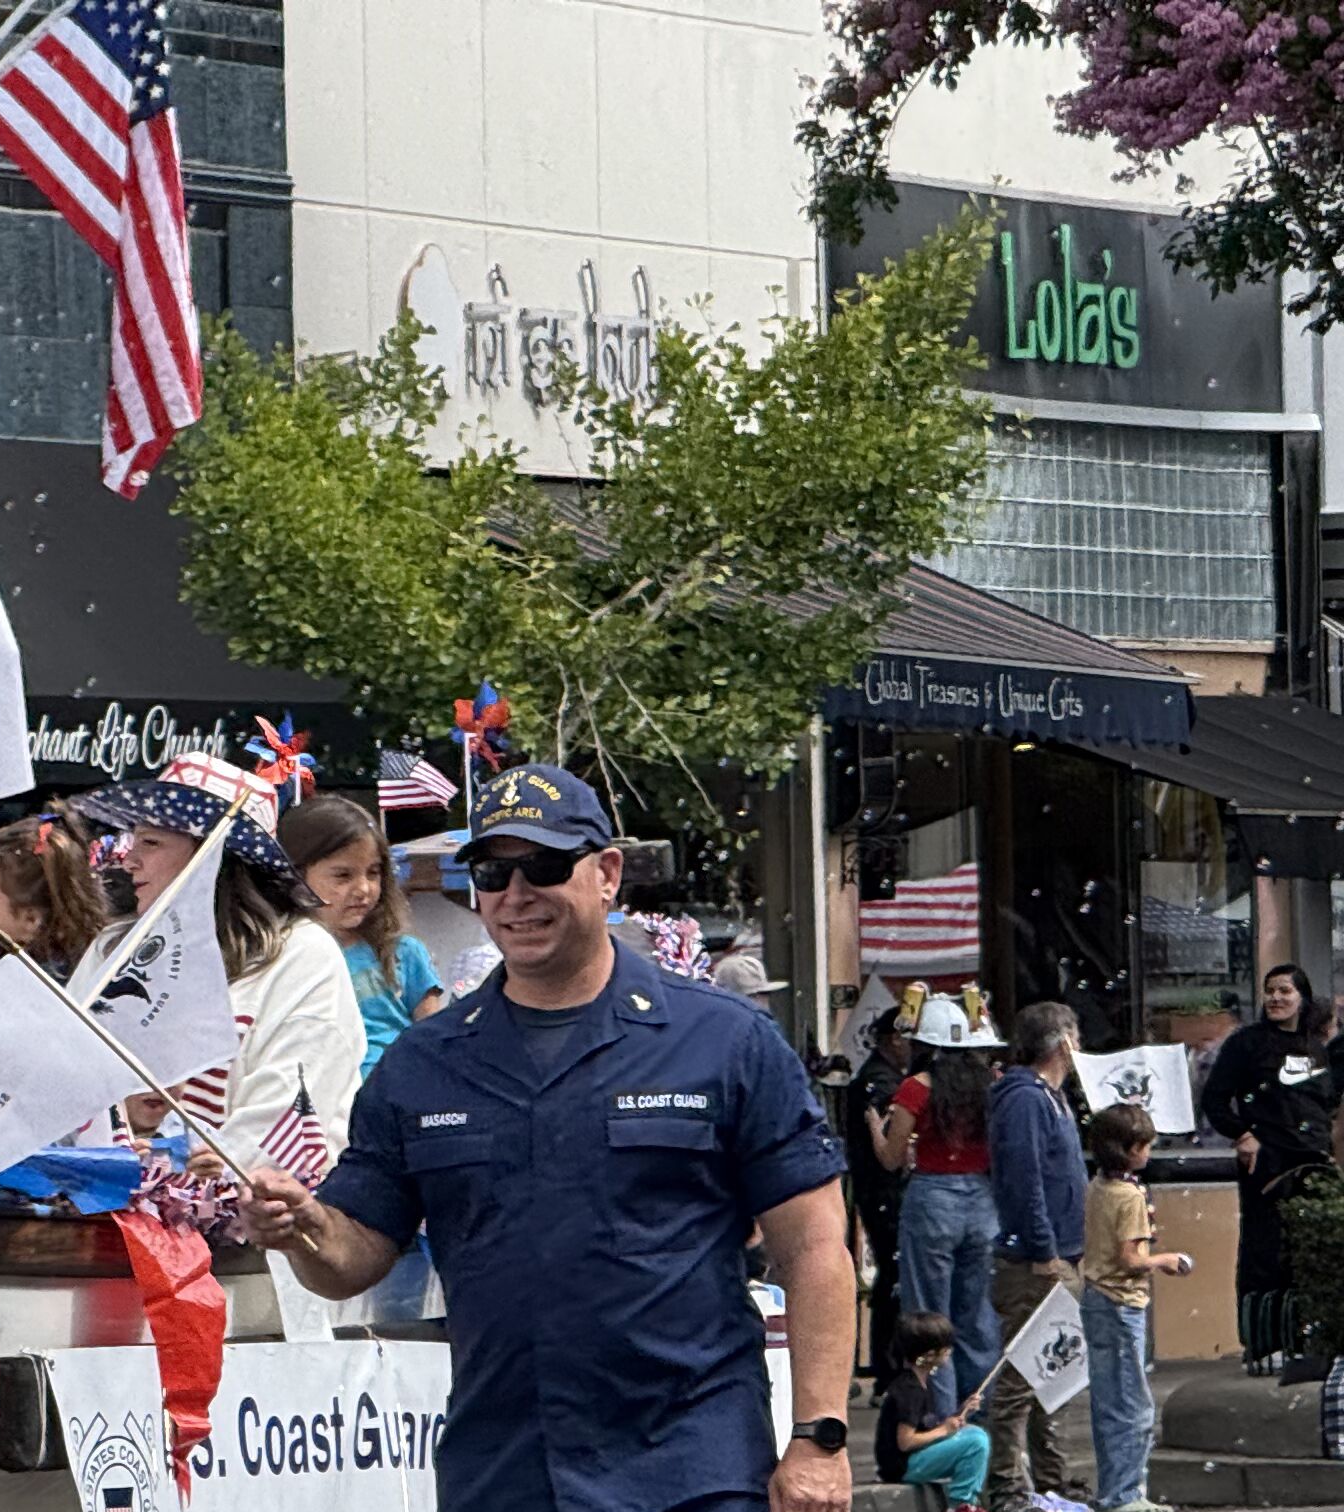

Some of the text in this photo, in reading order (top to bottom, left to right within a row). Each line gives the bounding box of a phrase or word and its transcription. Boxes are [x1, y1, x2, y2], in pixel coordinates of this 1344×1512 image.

[1001, 223, 1139, 368] Lola's
[865, 660, 912, 705] Global
[998, 673, 1046, 726] Unique
[1048, 677, 1084, 721] Gifts
[90, 702, 138, 782] Life
[142, 706, 227, 770] Church
[514, 807, 543, 820] AREA
[528, 775, 561, 800] GUARD
[617, 1093, 708, 1109] U.S. COAST GUARD
[238, 1396, 345, 1476] Coast
[84, 1445, 116, 1494] STATES
[119, 1445, 150, 1491] COAST
